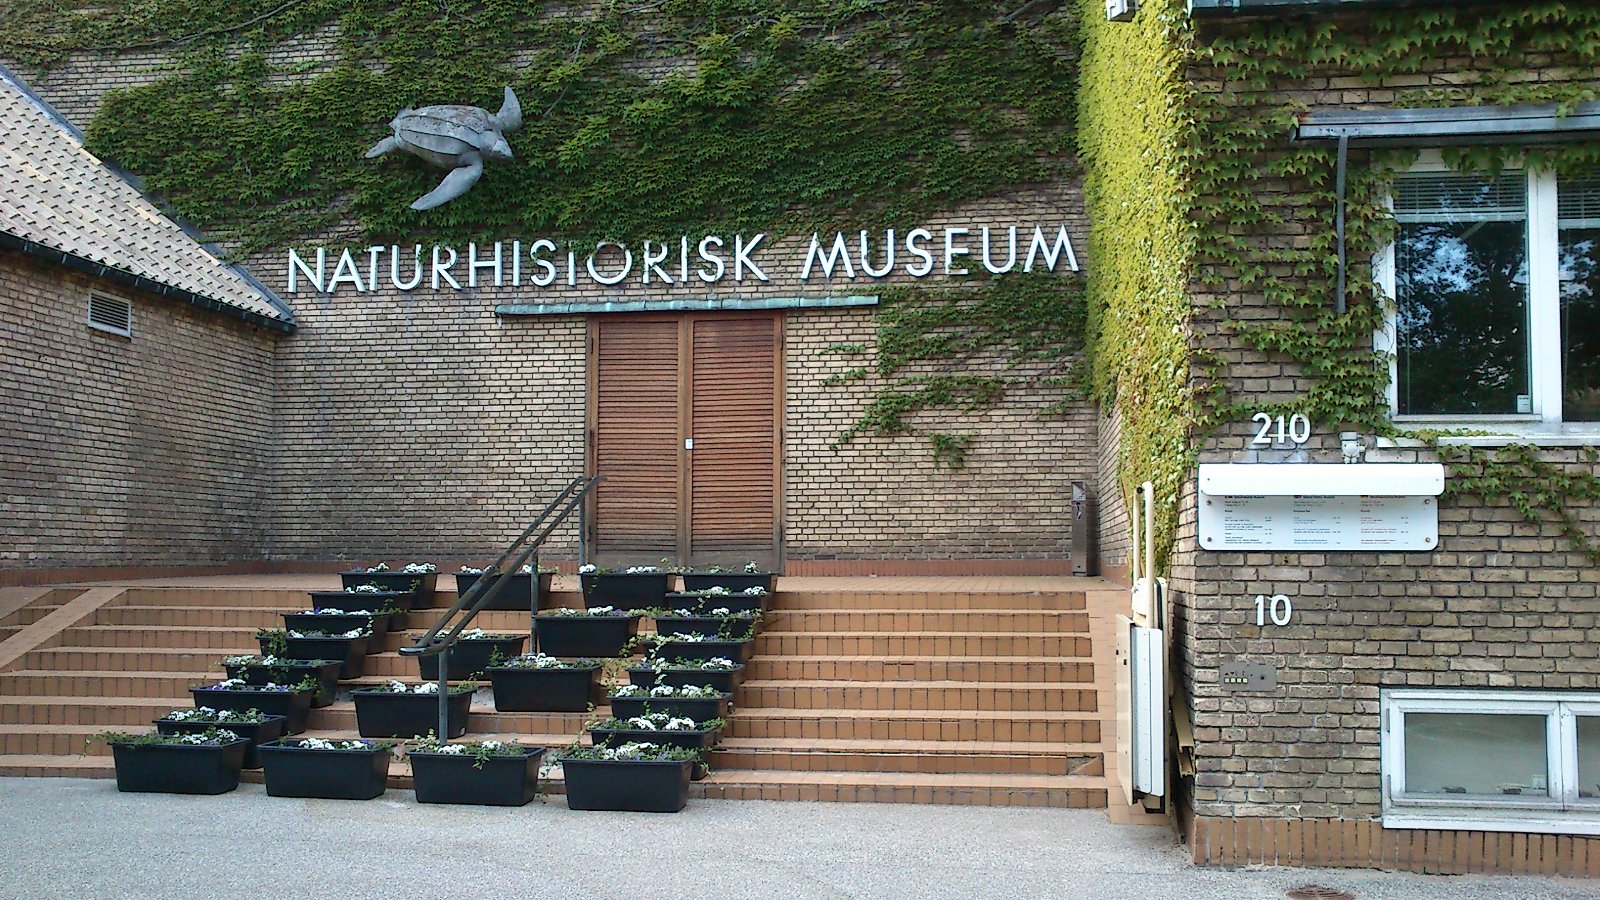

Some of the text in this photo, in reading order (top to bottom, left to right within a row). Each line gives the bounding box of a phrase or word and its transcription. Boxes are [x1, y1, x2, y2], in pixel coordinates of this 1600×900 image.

[801, 225, 1079, 279] MUSEUM
[1252, 412, 1311, 444] 210
[1255, 594, 1293, 626] 10
